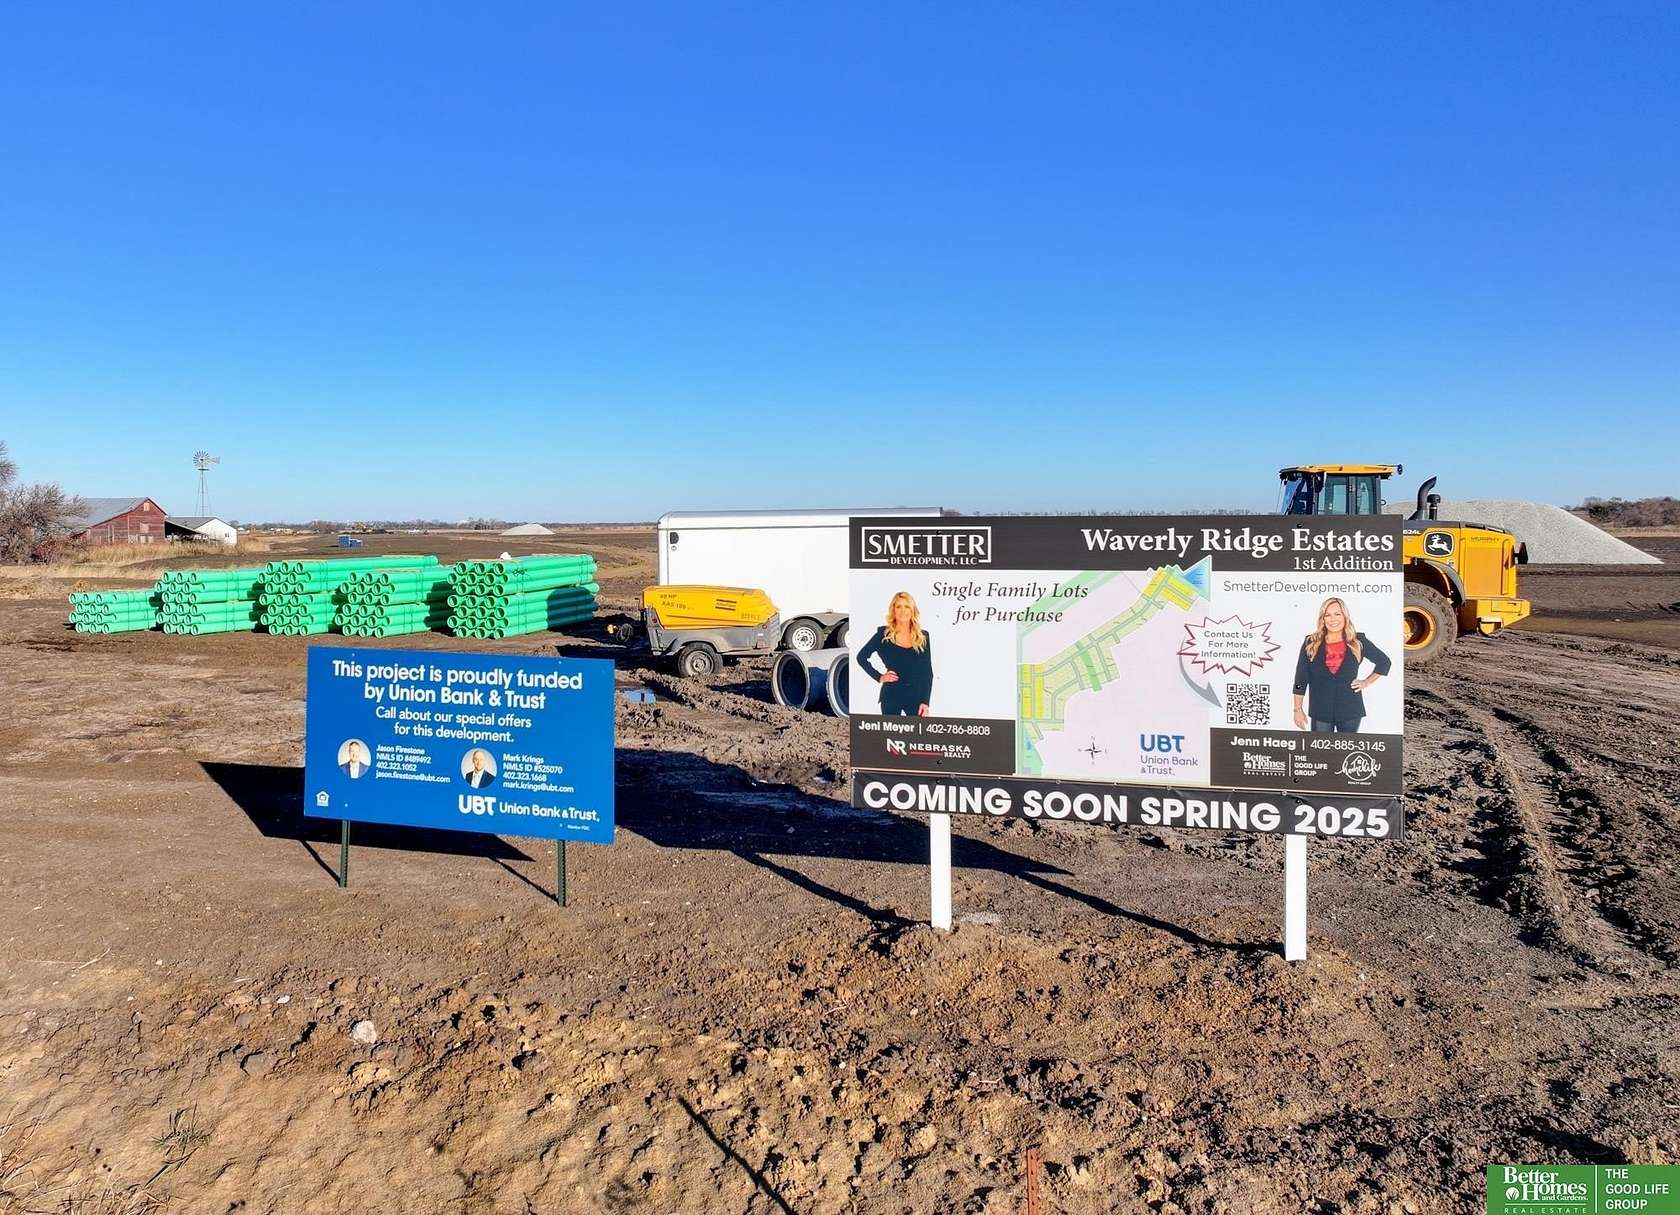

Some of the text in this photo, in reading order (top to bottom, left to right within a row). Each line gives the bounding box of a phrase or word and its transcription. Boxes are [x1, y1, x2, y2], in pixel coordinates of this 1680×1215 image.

[868, 534, 986, 556] SMETTER
[1081, 528, 1394, 558] Waverly Ridge Estates
[960, 557, 977, 565] LLC
[1294, 556, 1394, 571] 1st Addition
[932, 582, 1088, 602] Single Family Lots
[1223, 580, 1392, 595] SmetterDevelopment.com
[953, 606, 1063, 625] for Purchase
[1204, 630, 1239, 639] Contact
[1208, 640, 1223, 649] For
[1201, 650, 1256, 659] Information!
[332, 660, 582, 689] This project is proudly funded
[364, 682, 546, 710] by Union Bank & Trust
[376, 706, 532, 728] Call about our special offers
[394, 722, 514, 744] for this development.
[859, 721, 990, 735] Jeni Meyer 402-786-8808
[396, 746, 425, 754] Firestone
[909, 744, 971, 752] NEBRASKA
[1140, 734, 1184, 753] UBT
[1230, 736, 1386, 752] Jenn Haeg 402-885-3145
[522, 755, 544, 764] Krings
[1140, 754, 1198, 766] Union Bank
[1243, 752, 1272, 761] Better
[503, 762, 523, 771] NMLS
[1252, 760, 1286, 769] Homes
[503, 781, 575, 792] mark.krings@ubt.com
[459, 794, 496, 816] UBT
[500, 802, 530, 815] Union
[532, 805, 560, 818] Bank
[863, 781, 1389, 837] COMING SOON SPRING 2025
